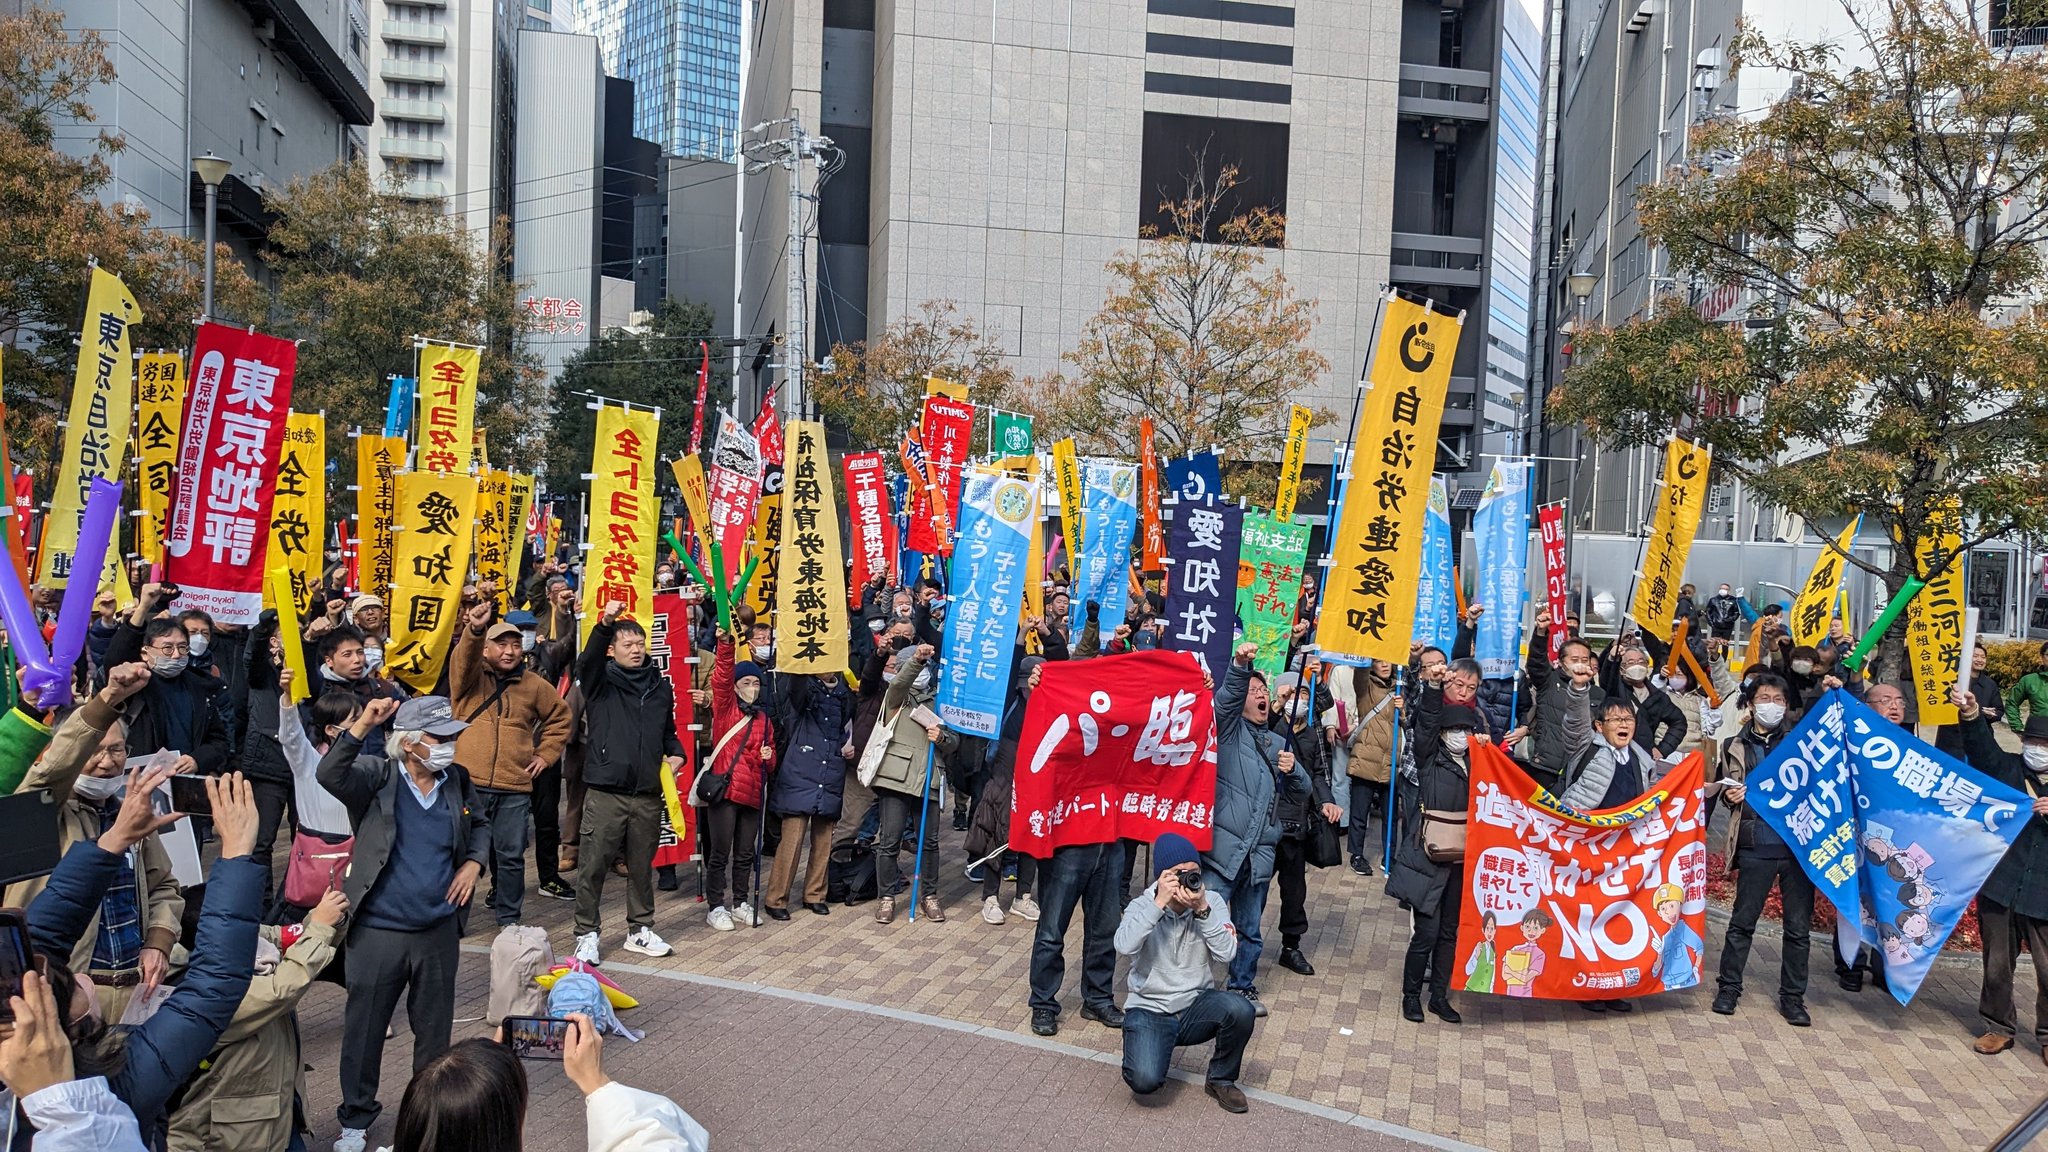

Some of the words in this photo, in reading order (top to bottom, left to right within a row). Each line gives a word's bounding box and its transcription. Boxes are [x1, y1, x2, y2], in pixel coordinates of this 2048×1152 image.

[522, 296, 583, 318] 大都会
[520, 321, 586, 335] パーキング
[141, 363, 158, 403] 労連
[159, 362, 177, 402] 国公
[729, 479, 751, 525] 建交労
[1259, 561, 1292, 582] 憲法
[1267, 580, 1279, 600] を
[975, 551, 1016, 682] 子どもたちに
[1253, 595, 1290, 617] 守れ
[1482, 854, 1530, 879] 職員を
[1479, 872, 1534, 898] 増やして
[1483, 894, 1523, 911] ほしい
[1547, 900, 1650, 961] NO
